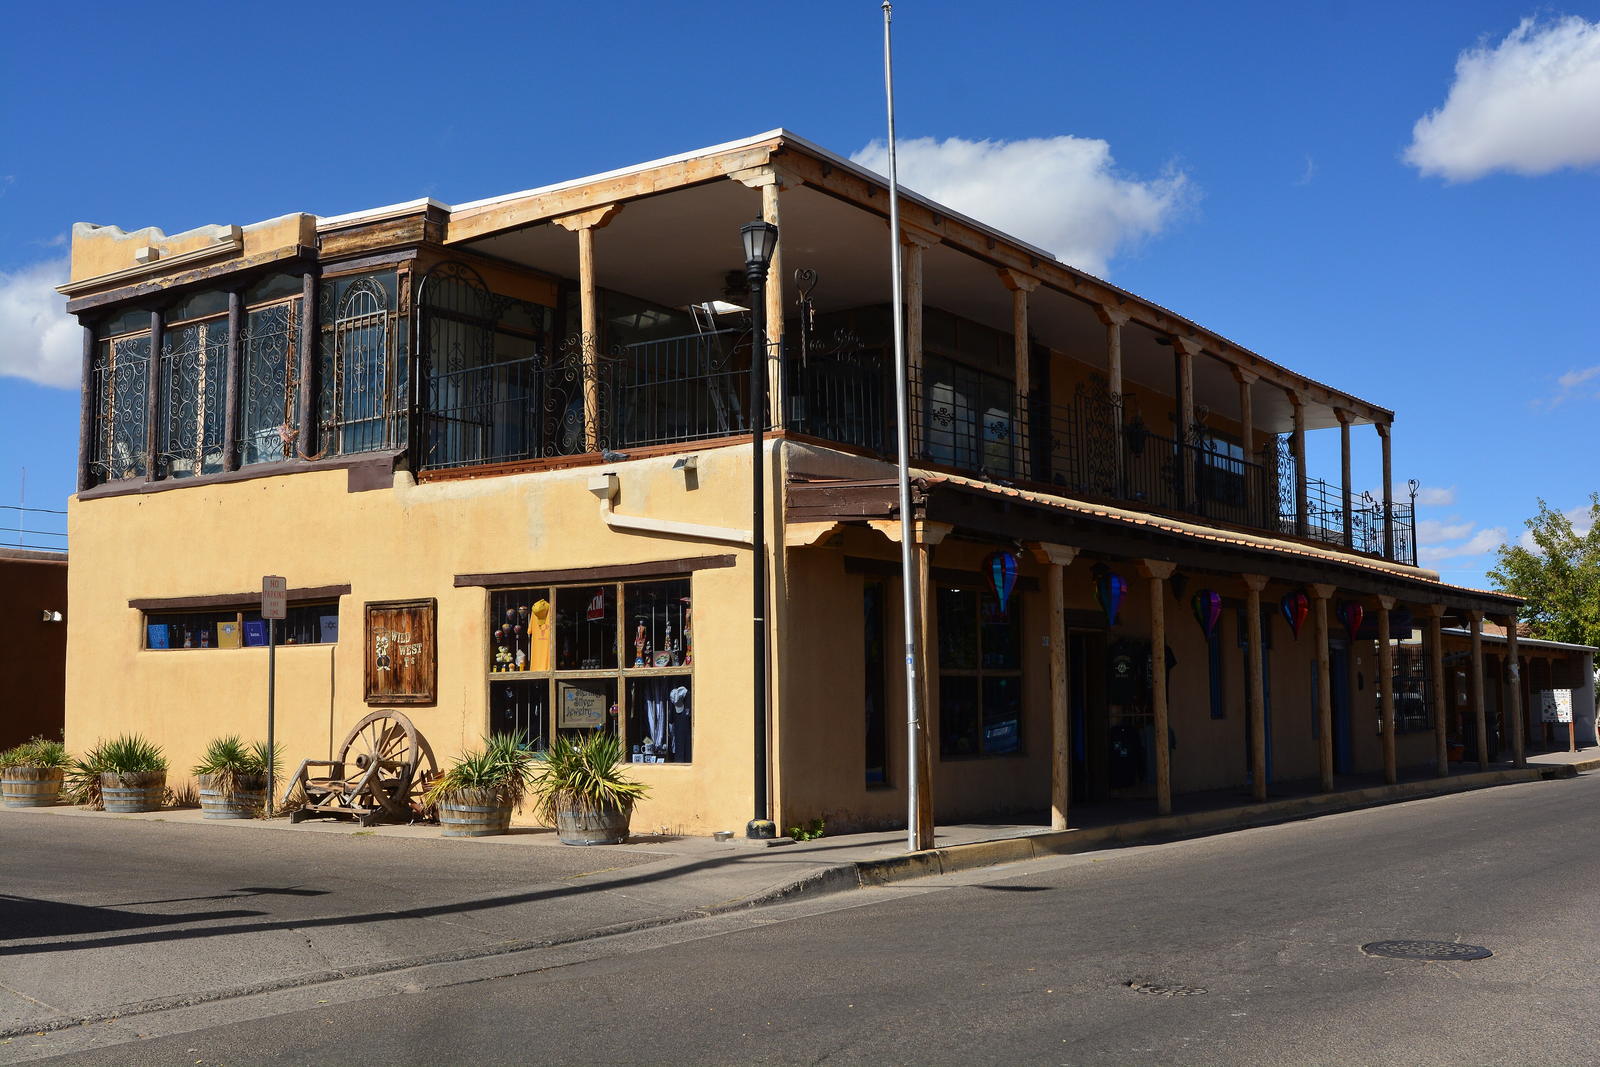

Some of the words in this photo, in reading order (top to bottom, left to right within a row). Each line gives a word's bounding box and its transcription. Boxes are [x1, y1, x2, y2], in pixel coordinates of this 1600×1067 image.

[270, 580, 279, 588] NO
[264, 590, 285, 599] PARKING
[587, 595, 603, 611] ATM
[391, 632, 411, 643] WILD
[398, 643, 422, 655] WEST
